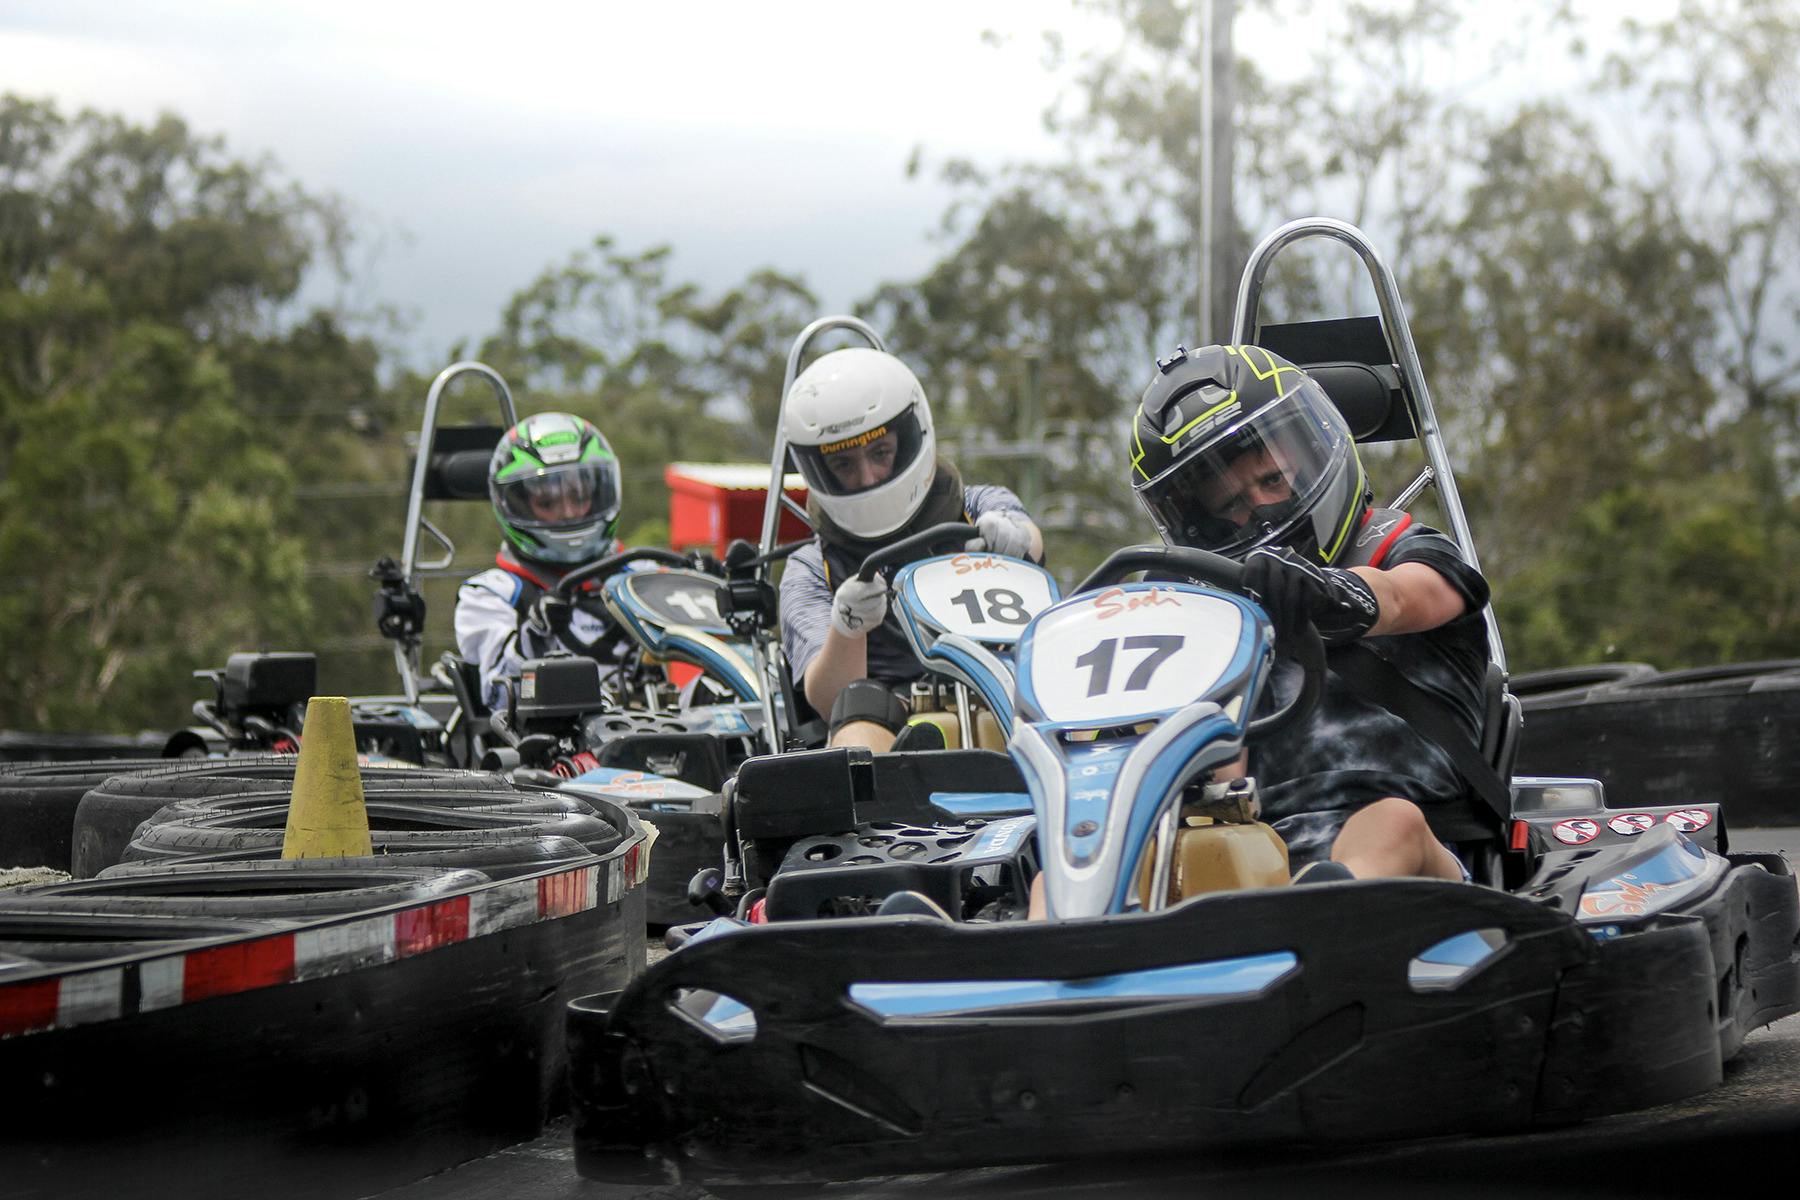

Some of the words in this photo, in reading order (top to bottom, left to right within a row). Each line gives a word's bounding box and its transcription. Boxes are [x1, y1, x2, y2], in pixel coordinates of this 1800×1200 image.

[820, 426, 887, 455] Durrington
[1170, 401, 1243, 457] LS2
[950, 588, 1032, 625] 18
[1075, 634, 1186, 698] 17
